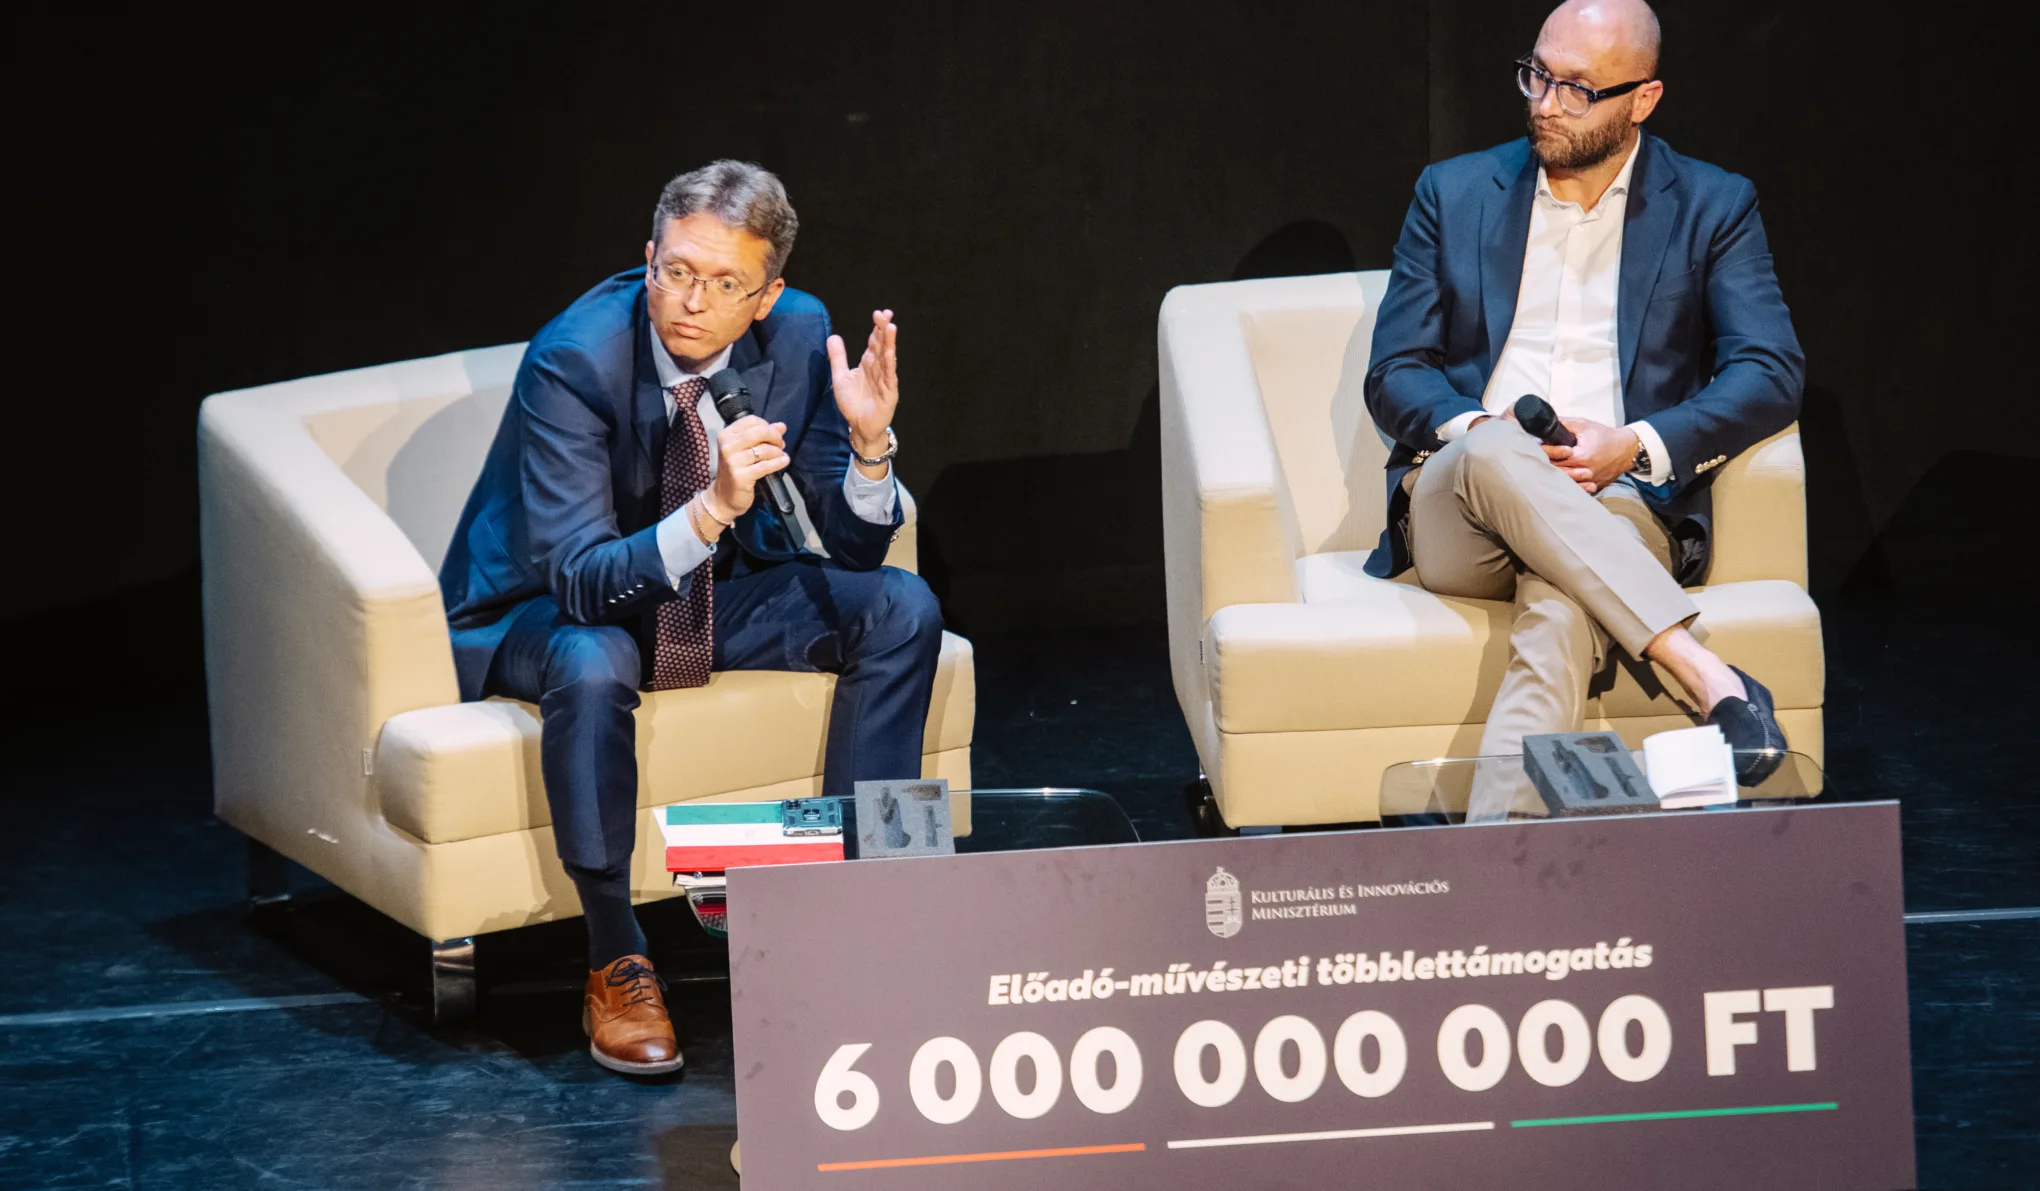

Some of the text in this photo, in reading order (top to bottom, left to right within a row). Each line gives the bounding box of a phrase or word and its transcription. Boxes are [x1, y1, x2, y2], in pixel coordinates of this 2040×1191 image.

[1251, 879, 1450, 904] KULTURÁLIS ÉS INNOVÁCIÓS
[1251, 903, 1358, 921] MINISZTÉRIUM
[987, 936, 1653, 1006] Előadó-művészeti többlettámogatás
[813, 984, 1835, 1131] 6 000 000 000 FT
